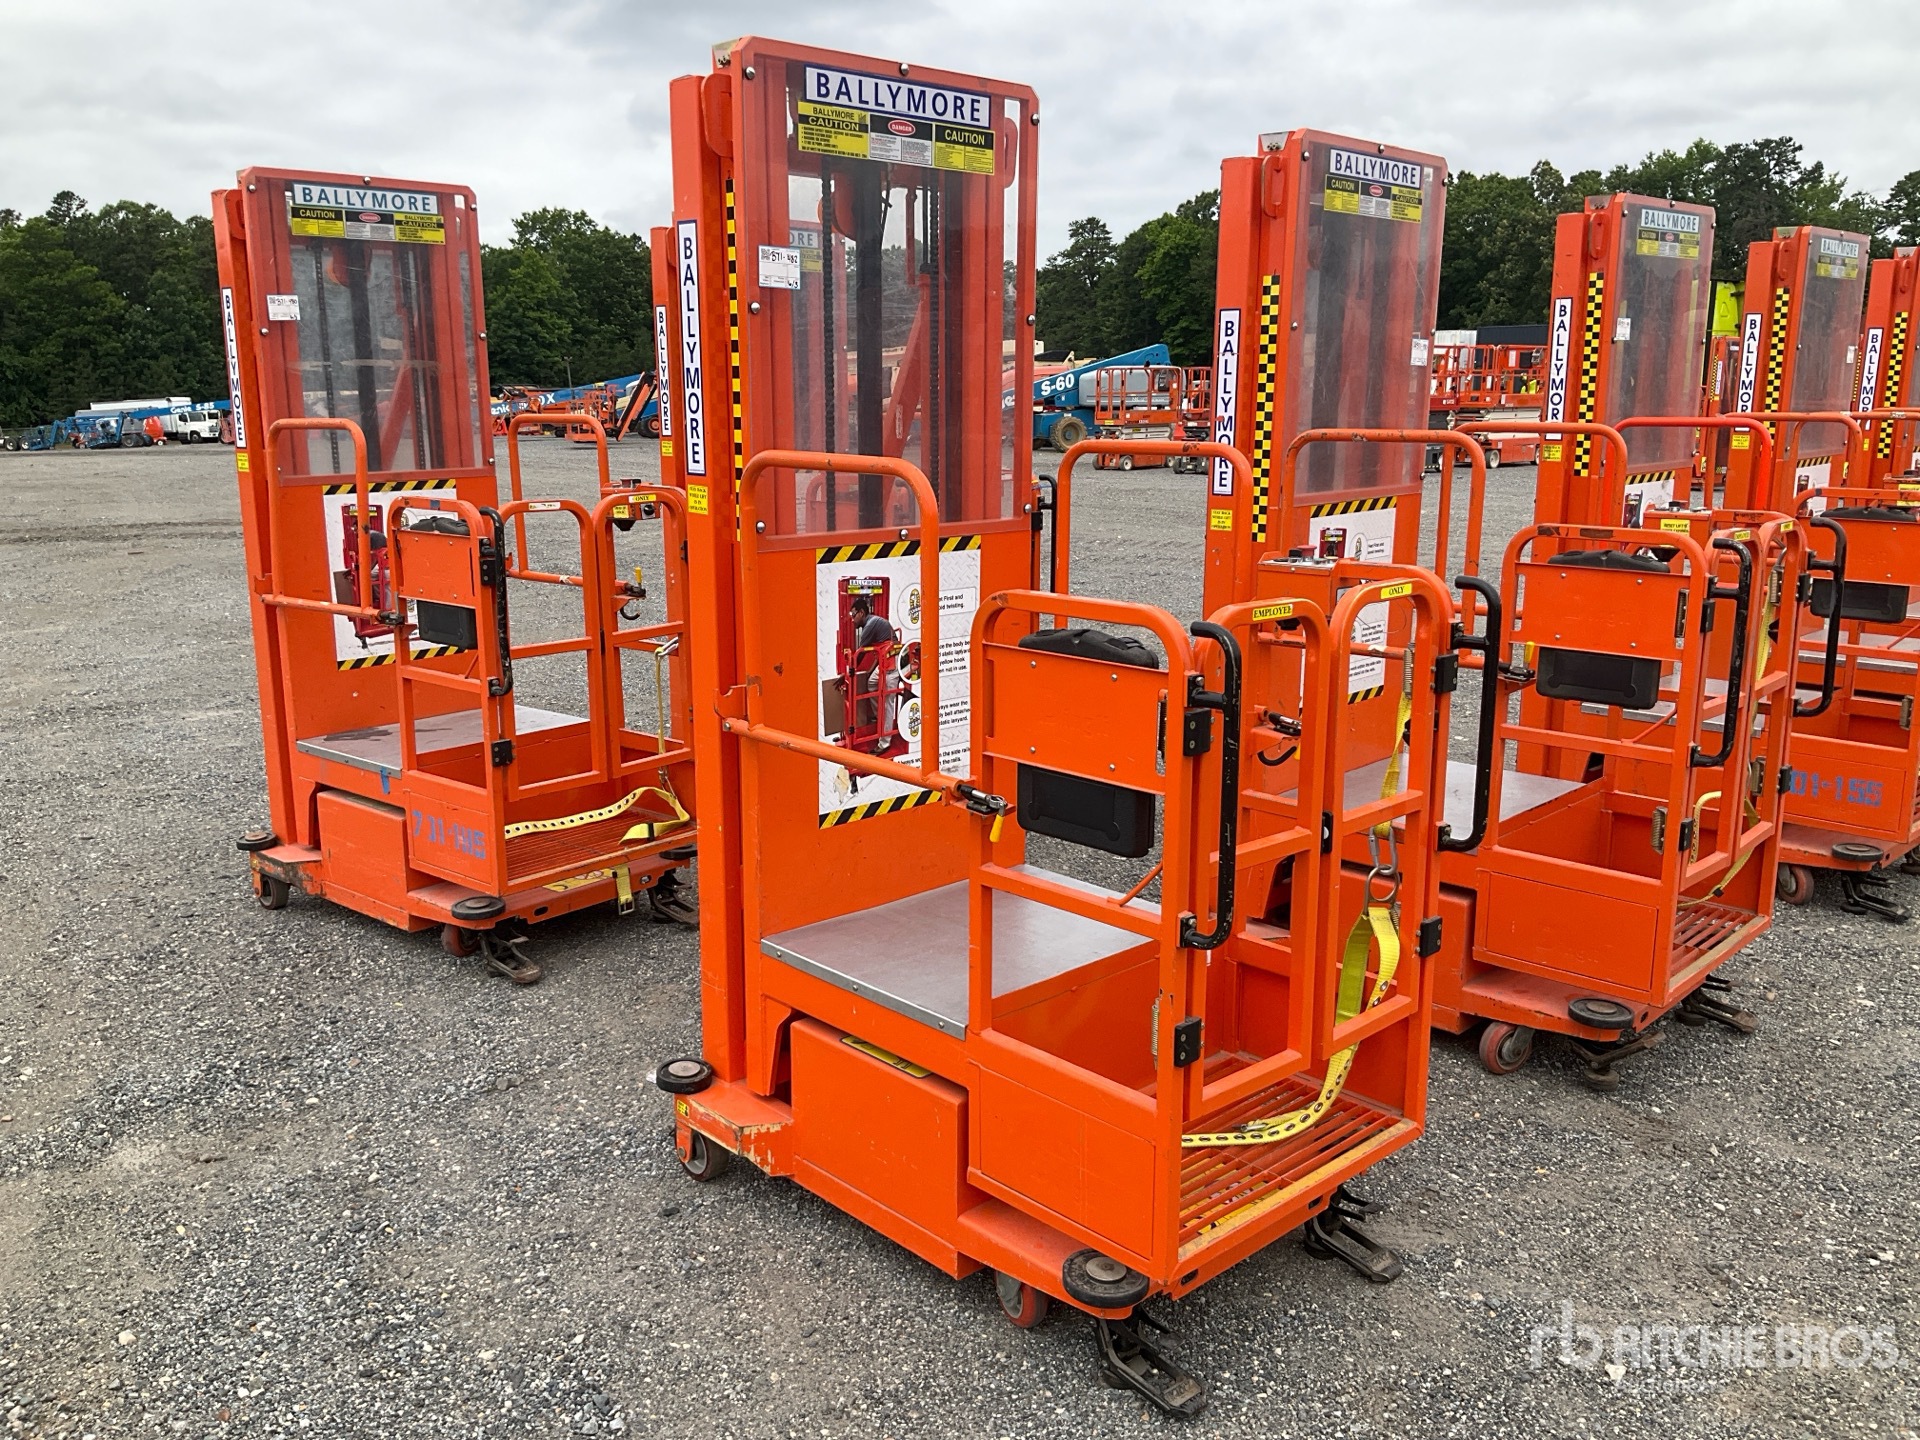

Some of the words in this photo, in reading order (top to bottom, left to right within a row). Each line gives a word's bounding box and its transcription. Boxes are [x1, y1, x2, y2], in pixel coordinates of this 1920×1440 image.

[817, 72, 980, 123] BALLYMORE
[808, 116, 859, 131] CAUTION
[813, 107, 855, 121] BALLYMORE
[891, 124, 912, 132] DANGER
[945, 129, 985, 146] CAUTION
[1335, 152, 1416, 185] BALLYMORE
[1331, 179, 1355, 190] CAUTION
[302, 186, 431, 212] BALLYMORE
[300, 209, 335, 219] CAUTION
[1645, 211, 1697, 231] BALLYMORE
[683, 236, 701, 465] BALLYMORE
[224, 294, 244, 442] BALLYMORE
[659, 310, 670, 431] BALLYMORE
[1550, 304, 1568, 421] BALLYMOR
[1740, 318, 1758, 413] BALLYMOR
[1041, 373, 1075, 396] S-60
[170, 406, 193, 414] Genie
[195, 401, 216, 411] S-85
[1389, 586, 1404, 595] ONLY
[1790, 770, 1883, 806] 01-155
